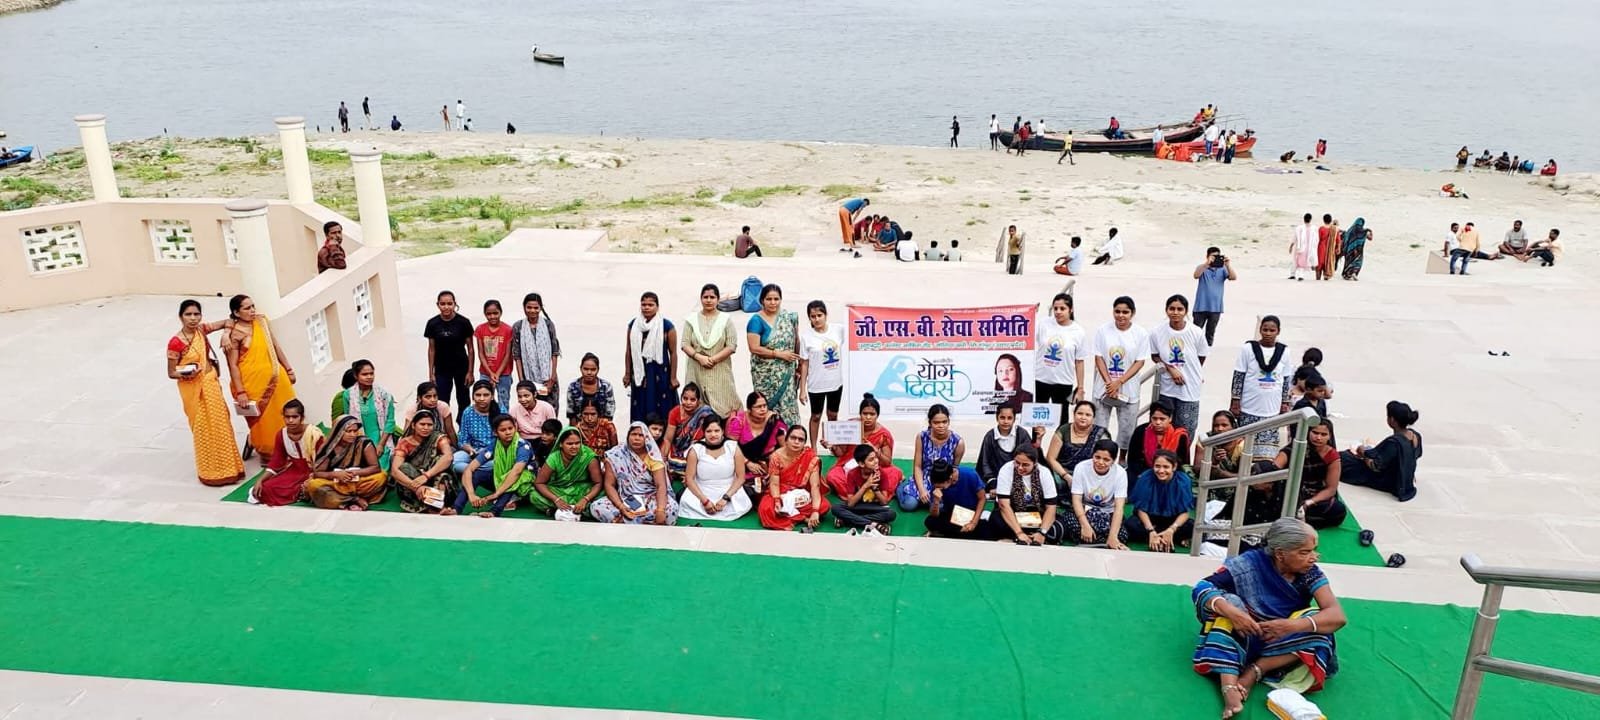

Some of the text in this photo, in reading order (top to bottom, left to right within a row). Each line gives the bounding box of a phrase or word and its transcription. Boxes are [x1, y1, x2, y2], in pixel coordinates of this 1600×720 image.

[977, 315, 1030, 336] समिति
[917, 358, 955, 380] योग
[904, 374, 963, 402] दिवस
